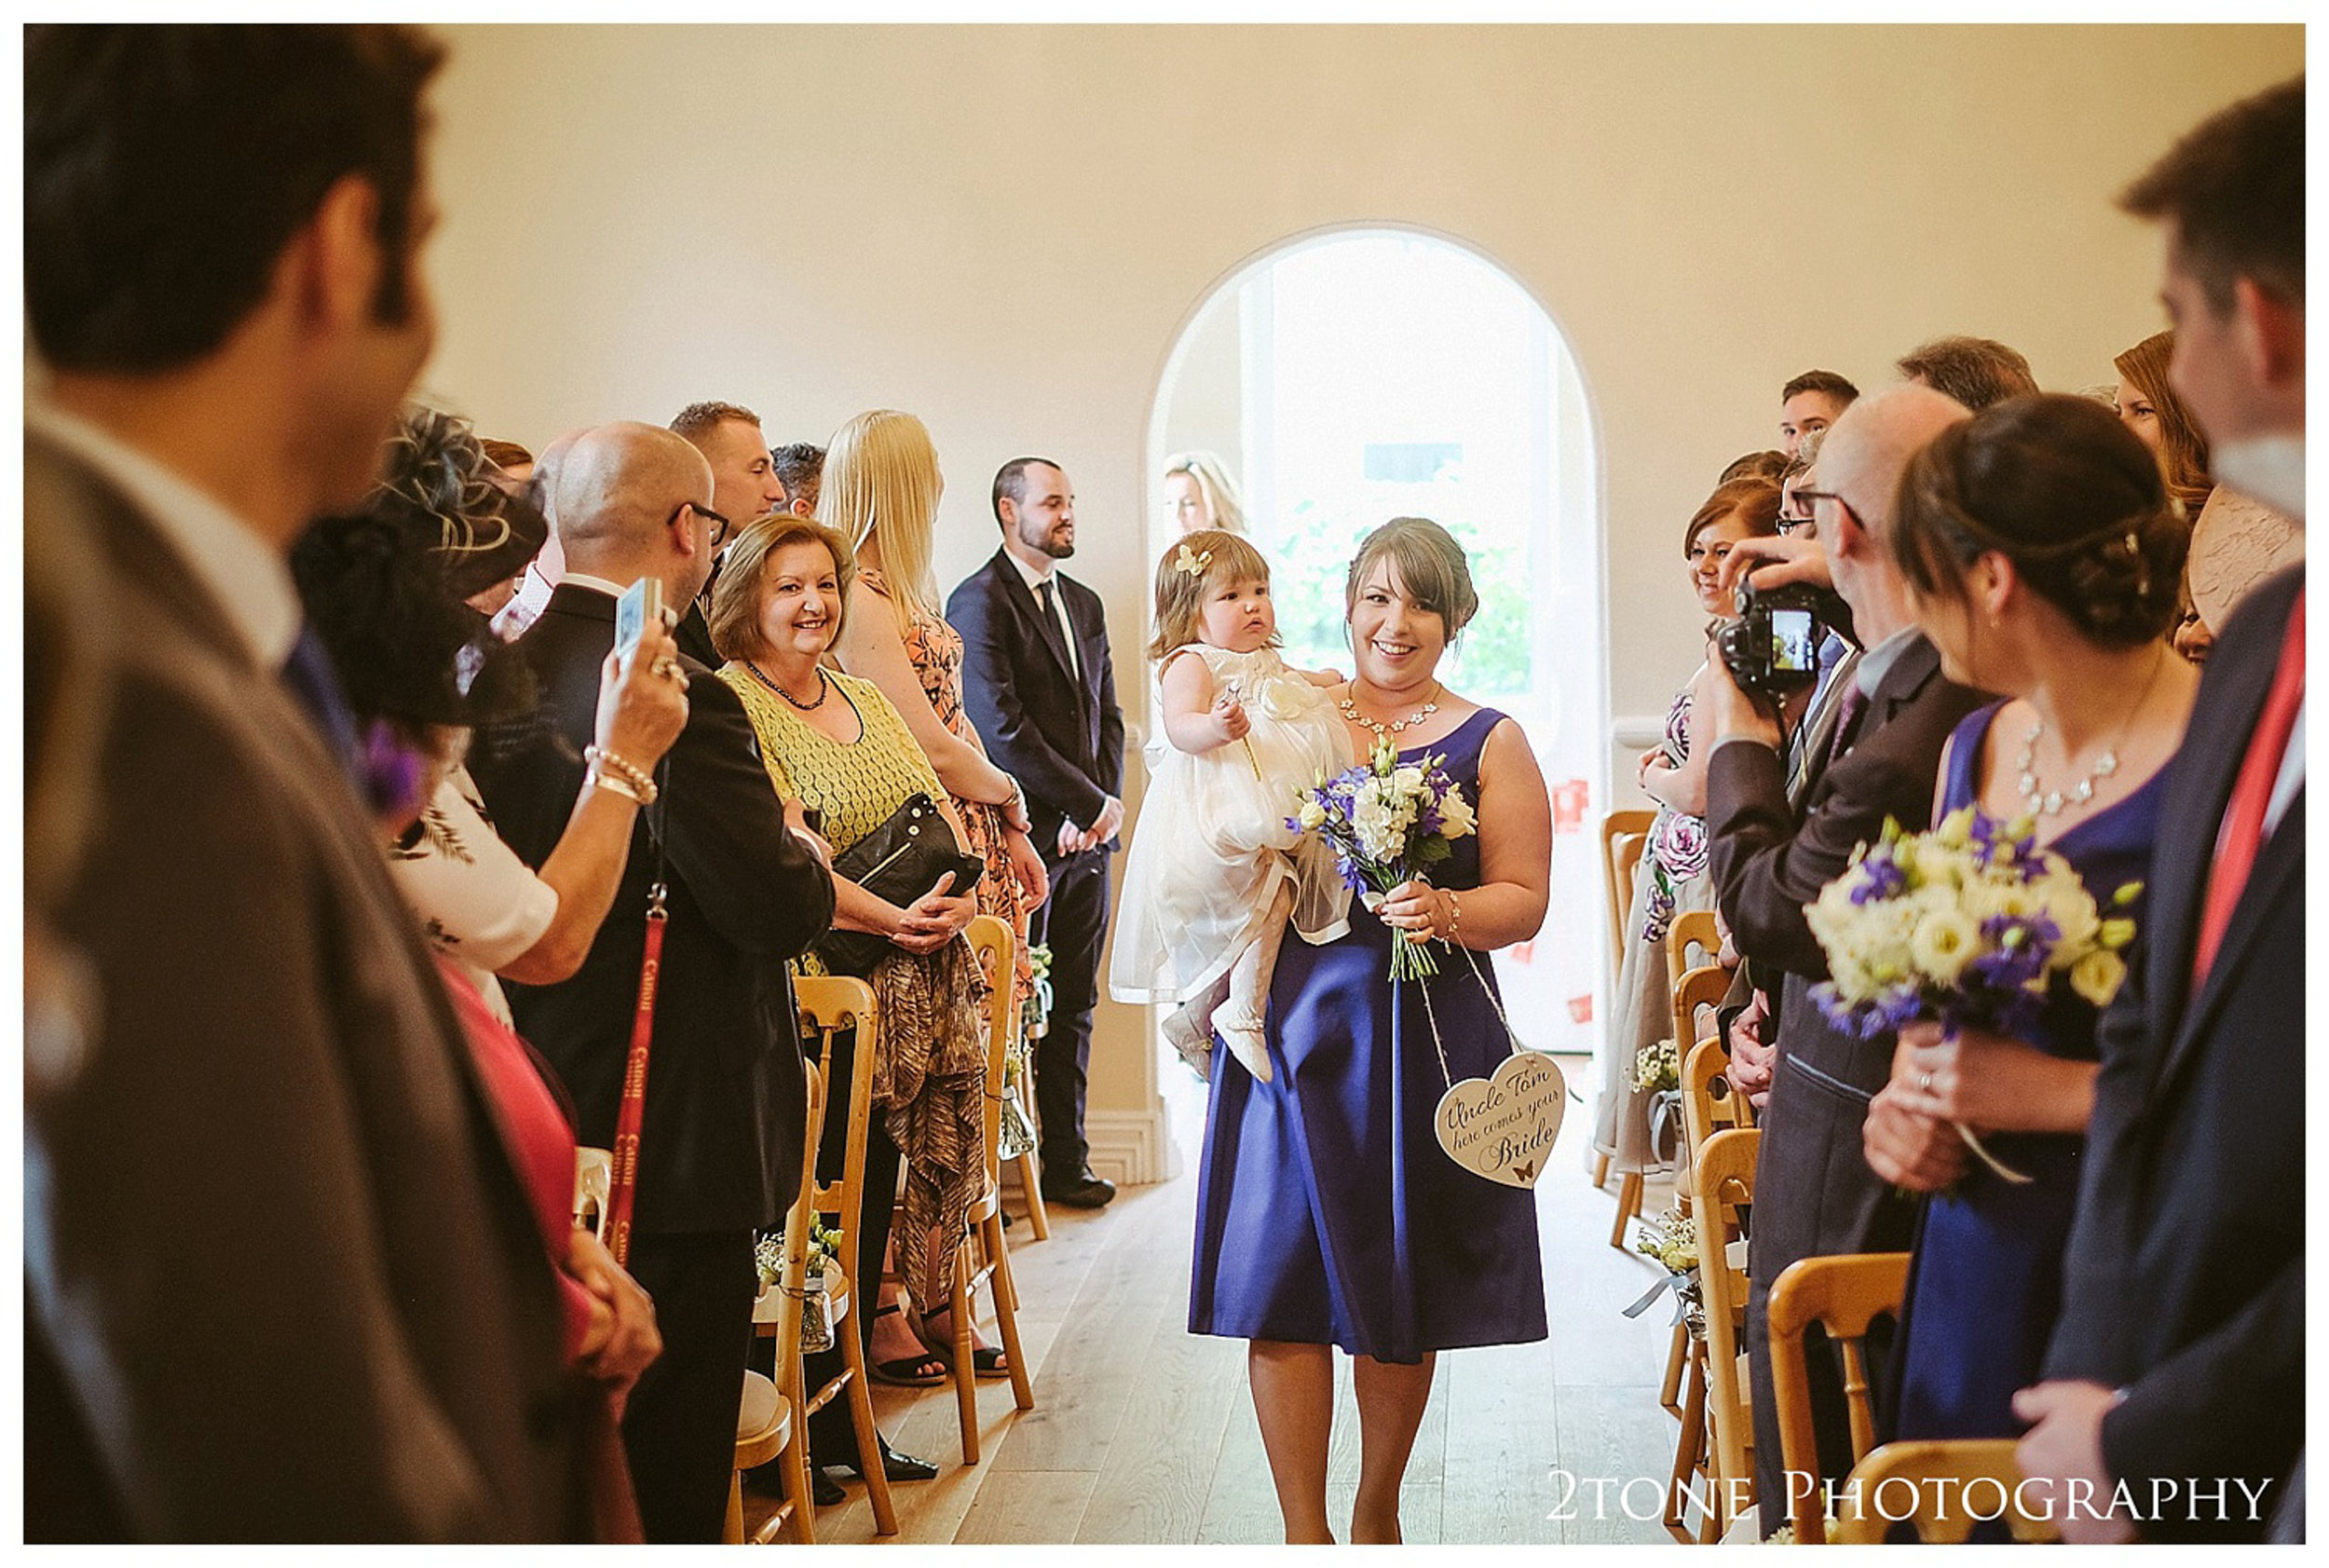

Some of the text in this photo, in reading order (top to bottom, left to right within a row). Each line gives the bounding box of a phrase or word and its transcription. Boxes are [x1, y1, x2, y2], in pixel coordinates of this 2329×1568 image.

[1445, 1070, 1551, 1129] Uncle Tom
[1452, 1089, 1559, 1152] here comes your
[1478, 1117, 1554, 1173] Bride
